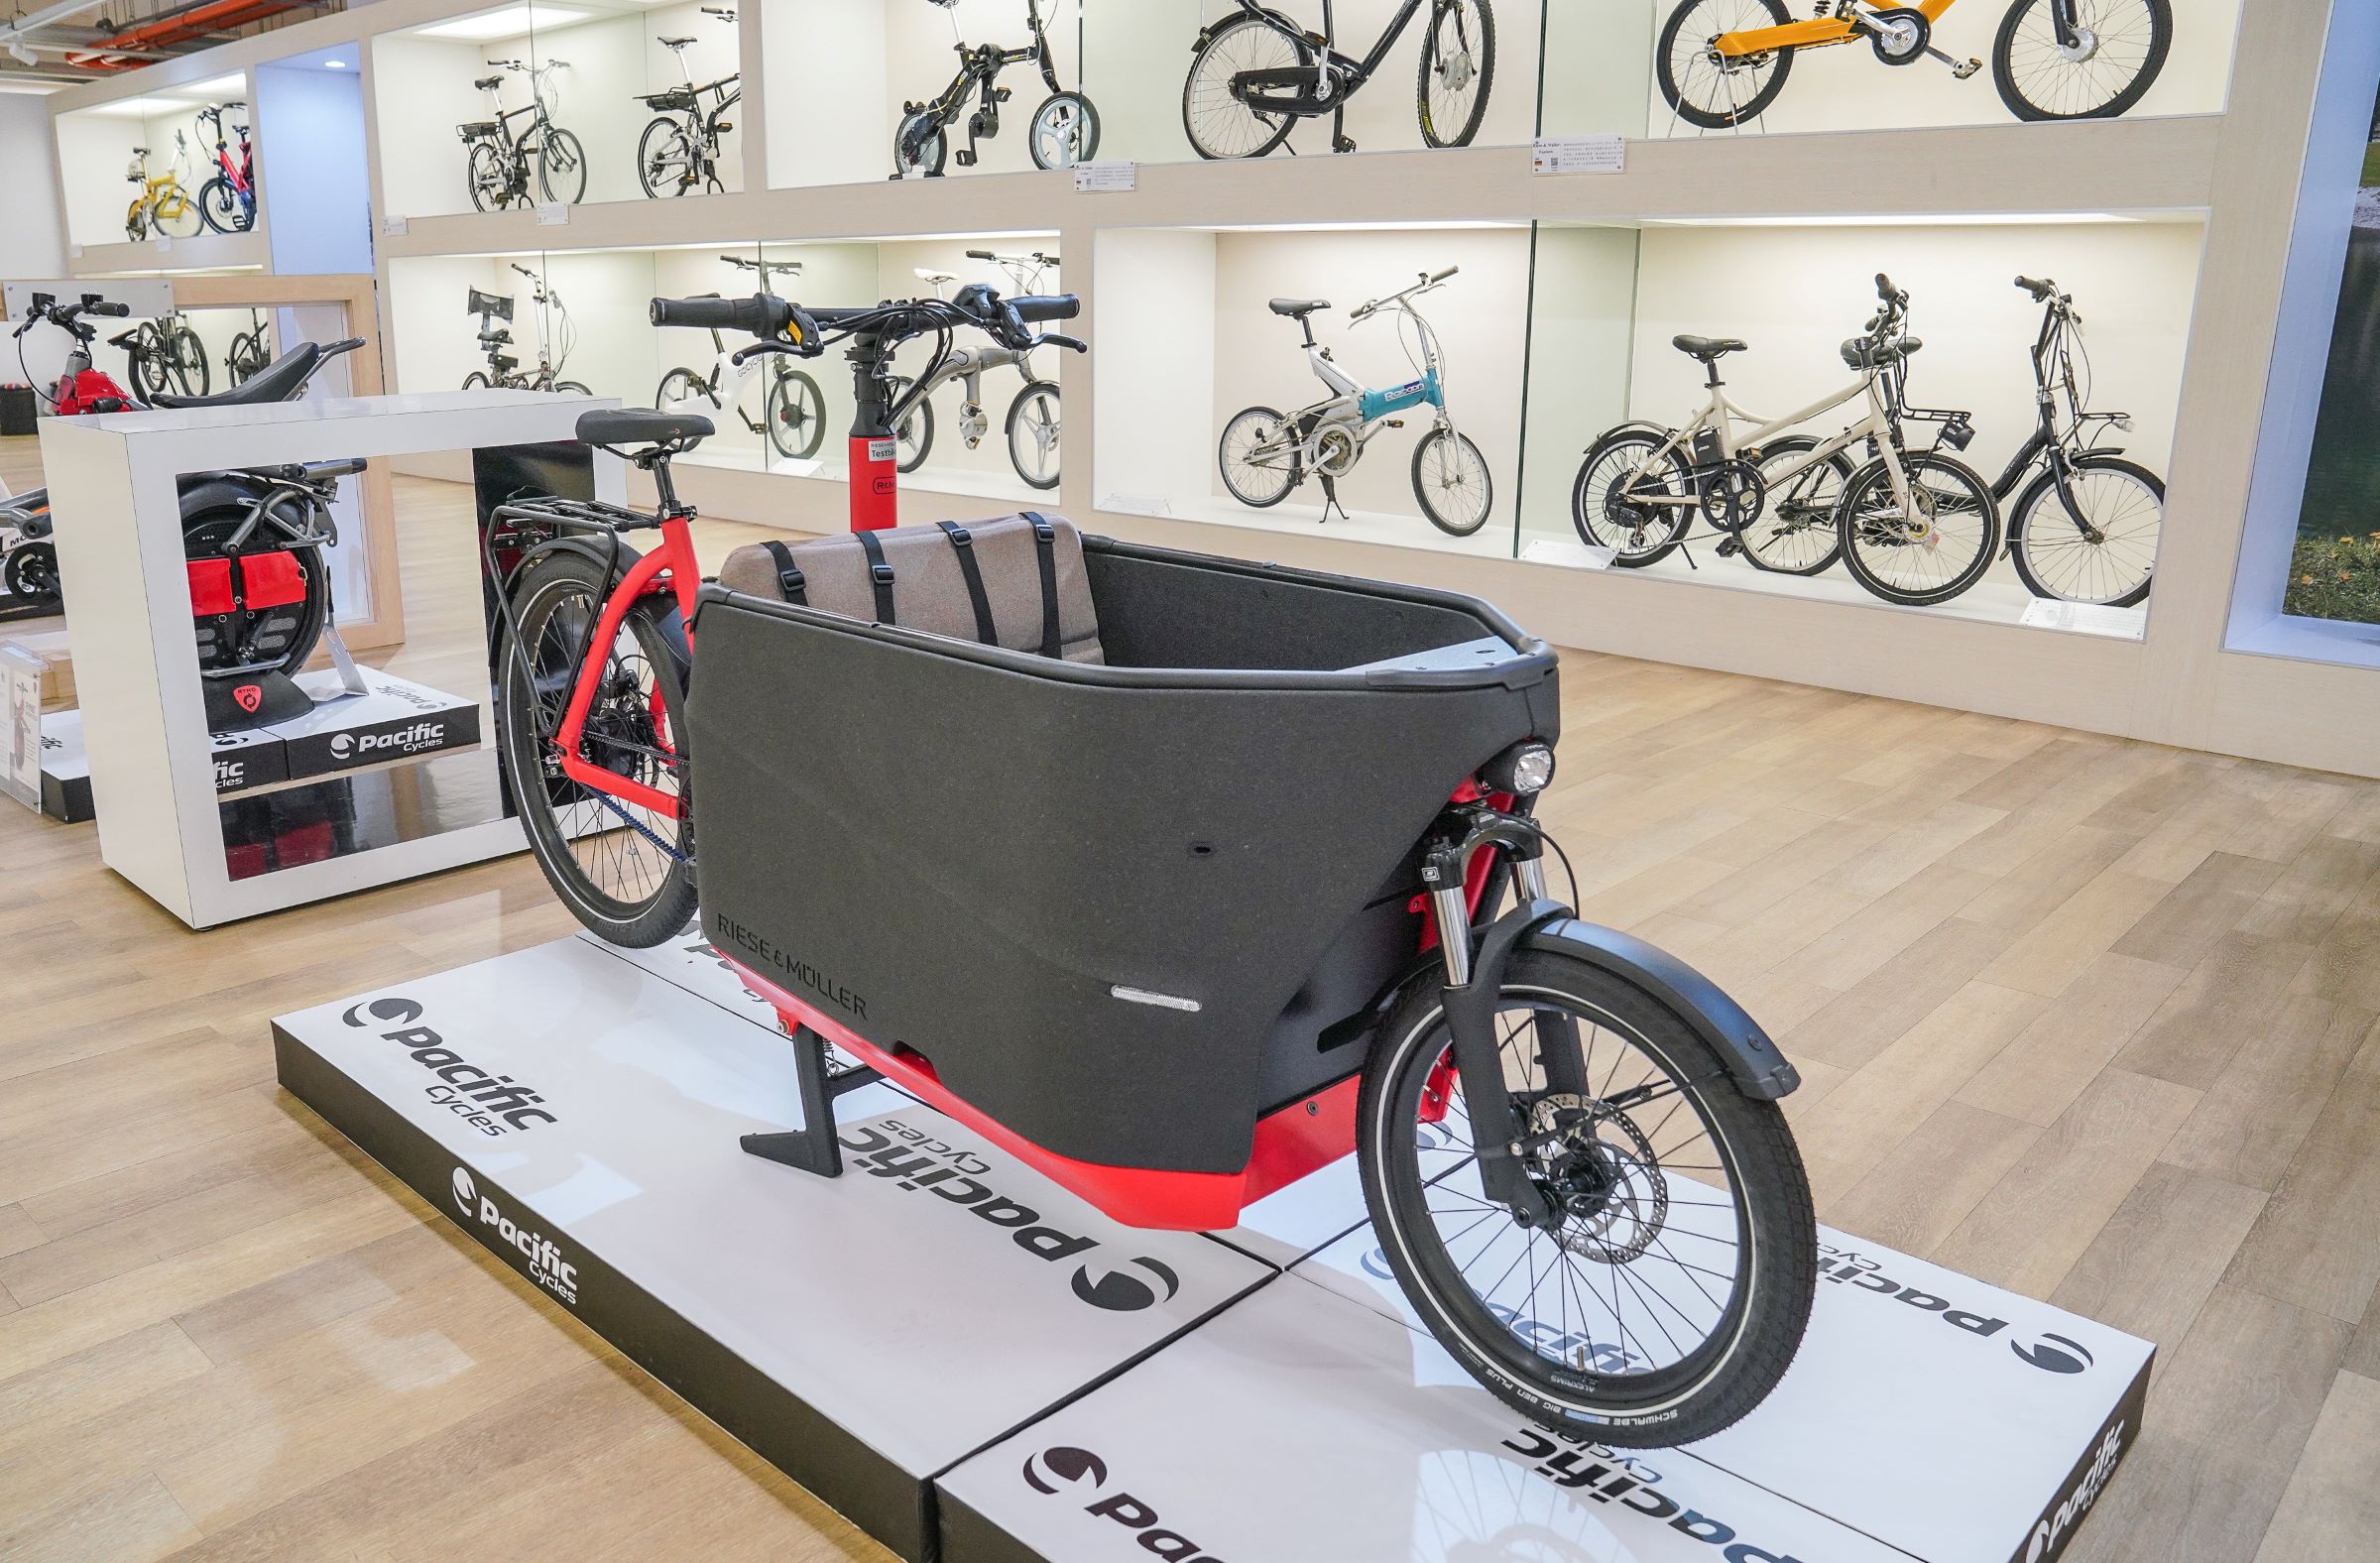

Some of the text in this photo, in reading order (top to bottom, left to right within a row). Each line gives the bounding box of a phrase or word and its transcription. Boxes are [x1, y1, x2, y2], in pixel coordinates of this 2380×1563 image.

[359, 722, 444, 753] Pacific
[403, 737, 443, 753] Cycles
[215, 777, 244, 788] cles
[380, 1025, 558, 1132] Pacific
[424, 1085, 508, 1137] Cycles
[879, 1119, 992, 1175] Cycles
[838, 1127, 1102, 1262] Pacific
[480, 1195, 577, 1291] Pacific
[1818, 1245, 1883, 1270] Cyc
[529, 1260, 577, 1305] Cycles
[1817, 1257, 2010, 1338] Paci
[1486, 1367, 1514, 1390] PLUS
[1542, 1401, 1561, 1414] BIG
[1612, 1408, 1679, 1427] SCHWALBE
[2046, 1419, 2124, 1553] Pacific
